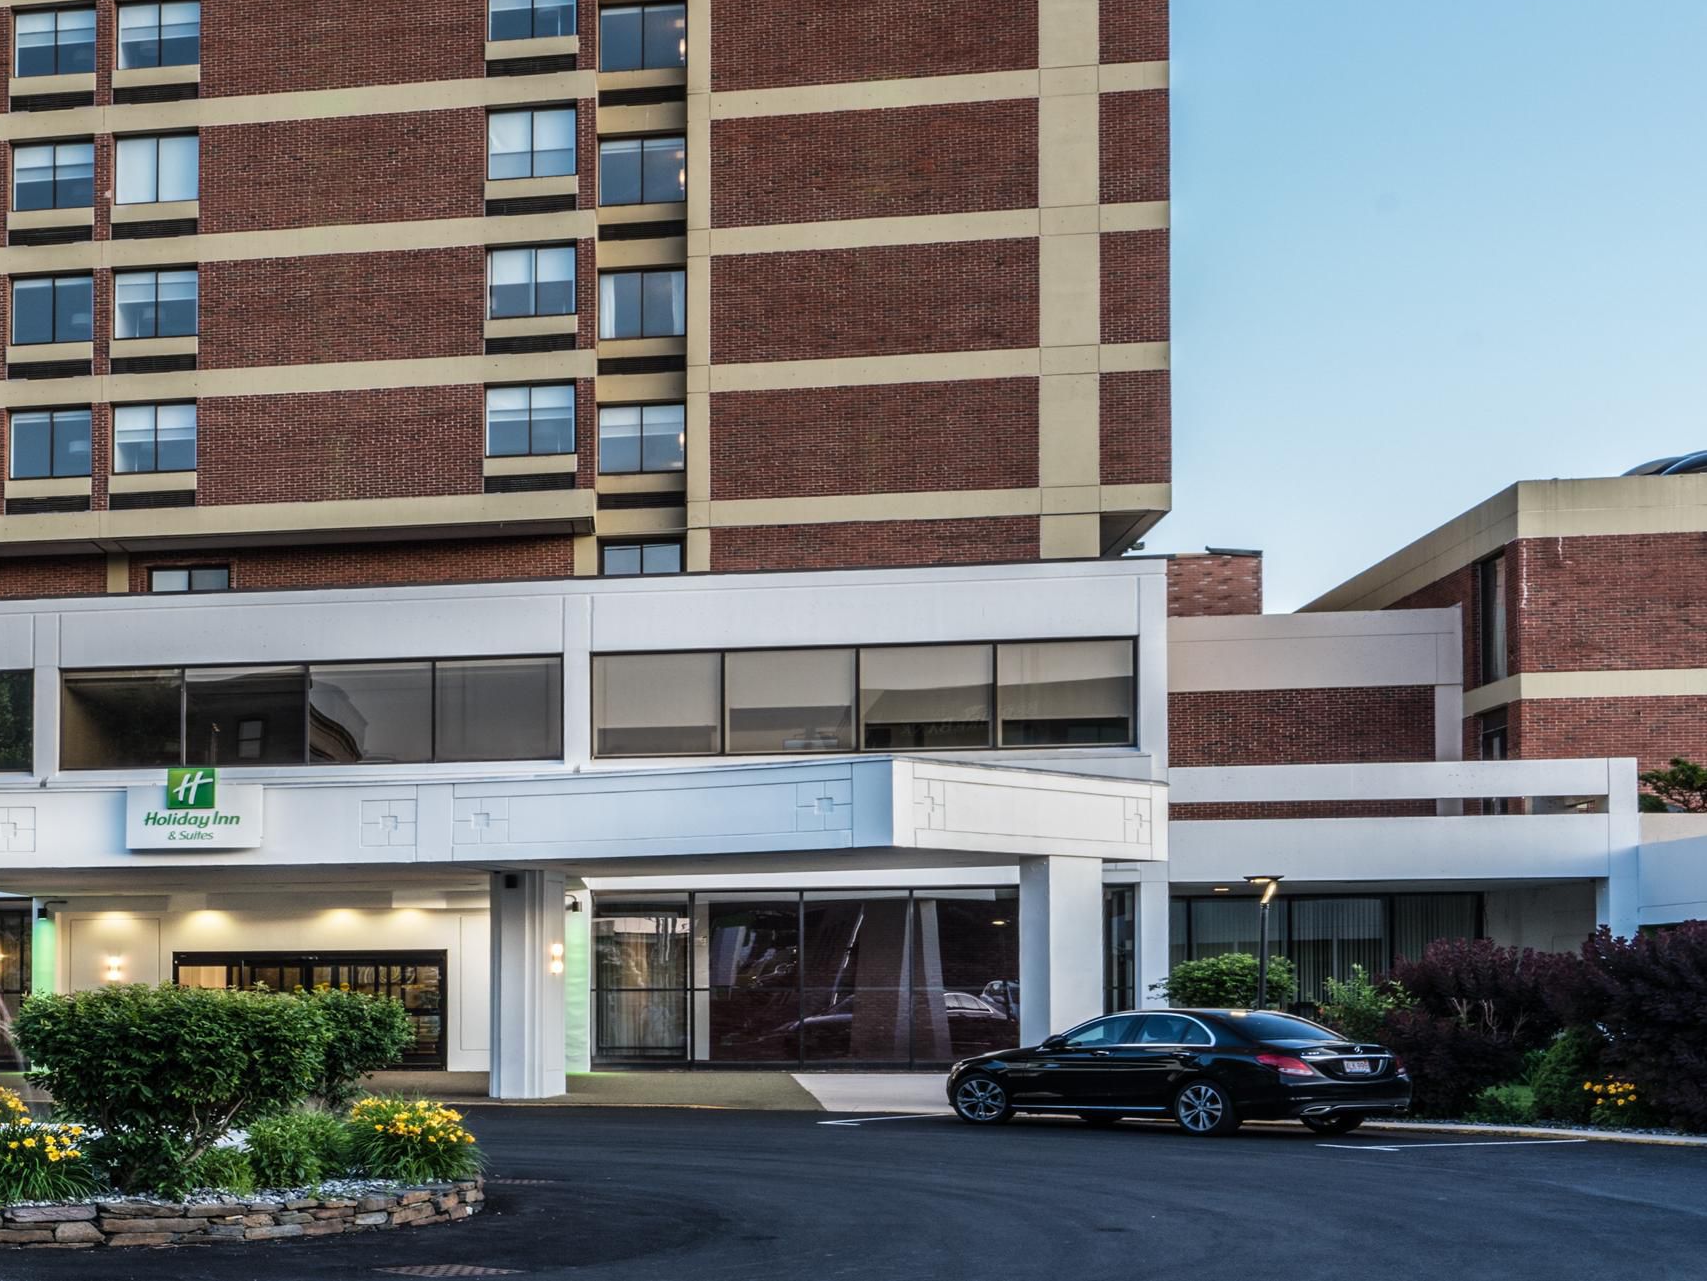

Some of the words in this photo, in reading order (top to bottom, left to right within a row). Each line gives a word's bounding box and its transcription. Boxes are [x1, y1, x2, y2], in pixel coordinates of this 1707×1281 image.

[144, 811, 210, 828] Holiday
[212, 810, 241, 826] Inn
[167, 830, 177, 841] &
[178, 830, 214, 841] Suites
